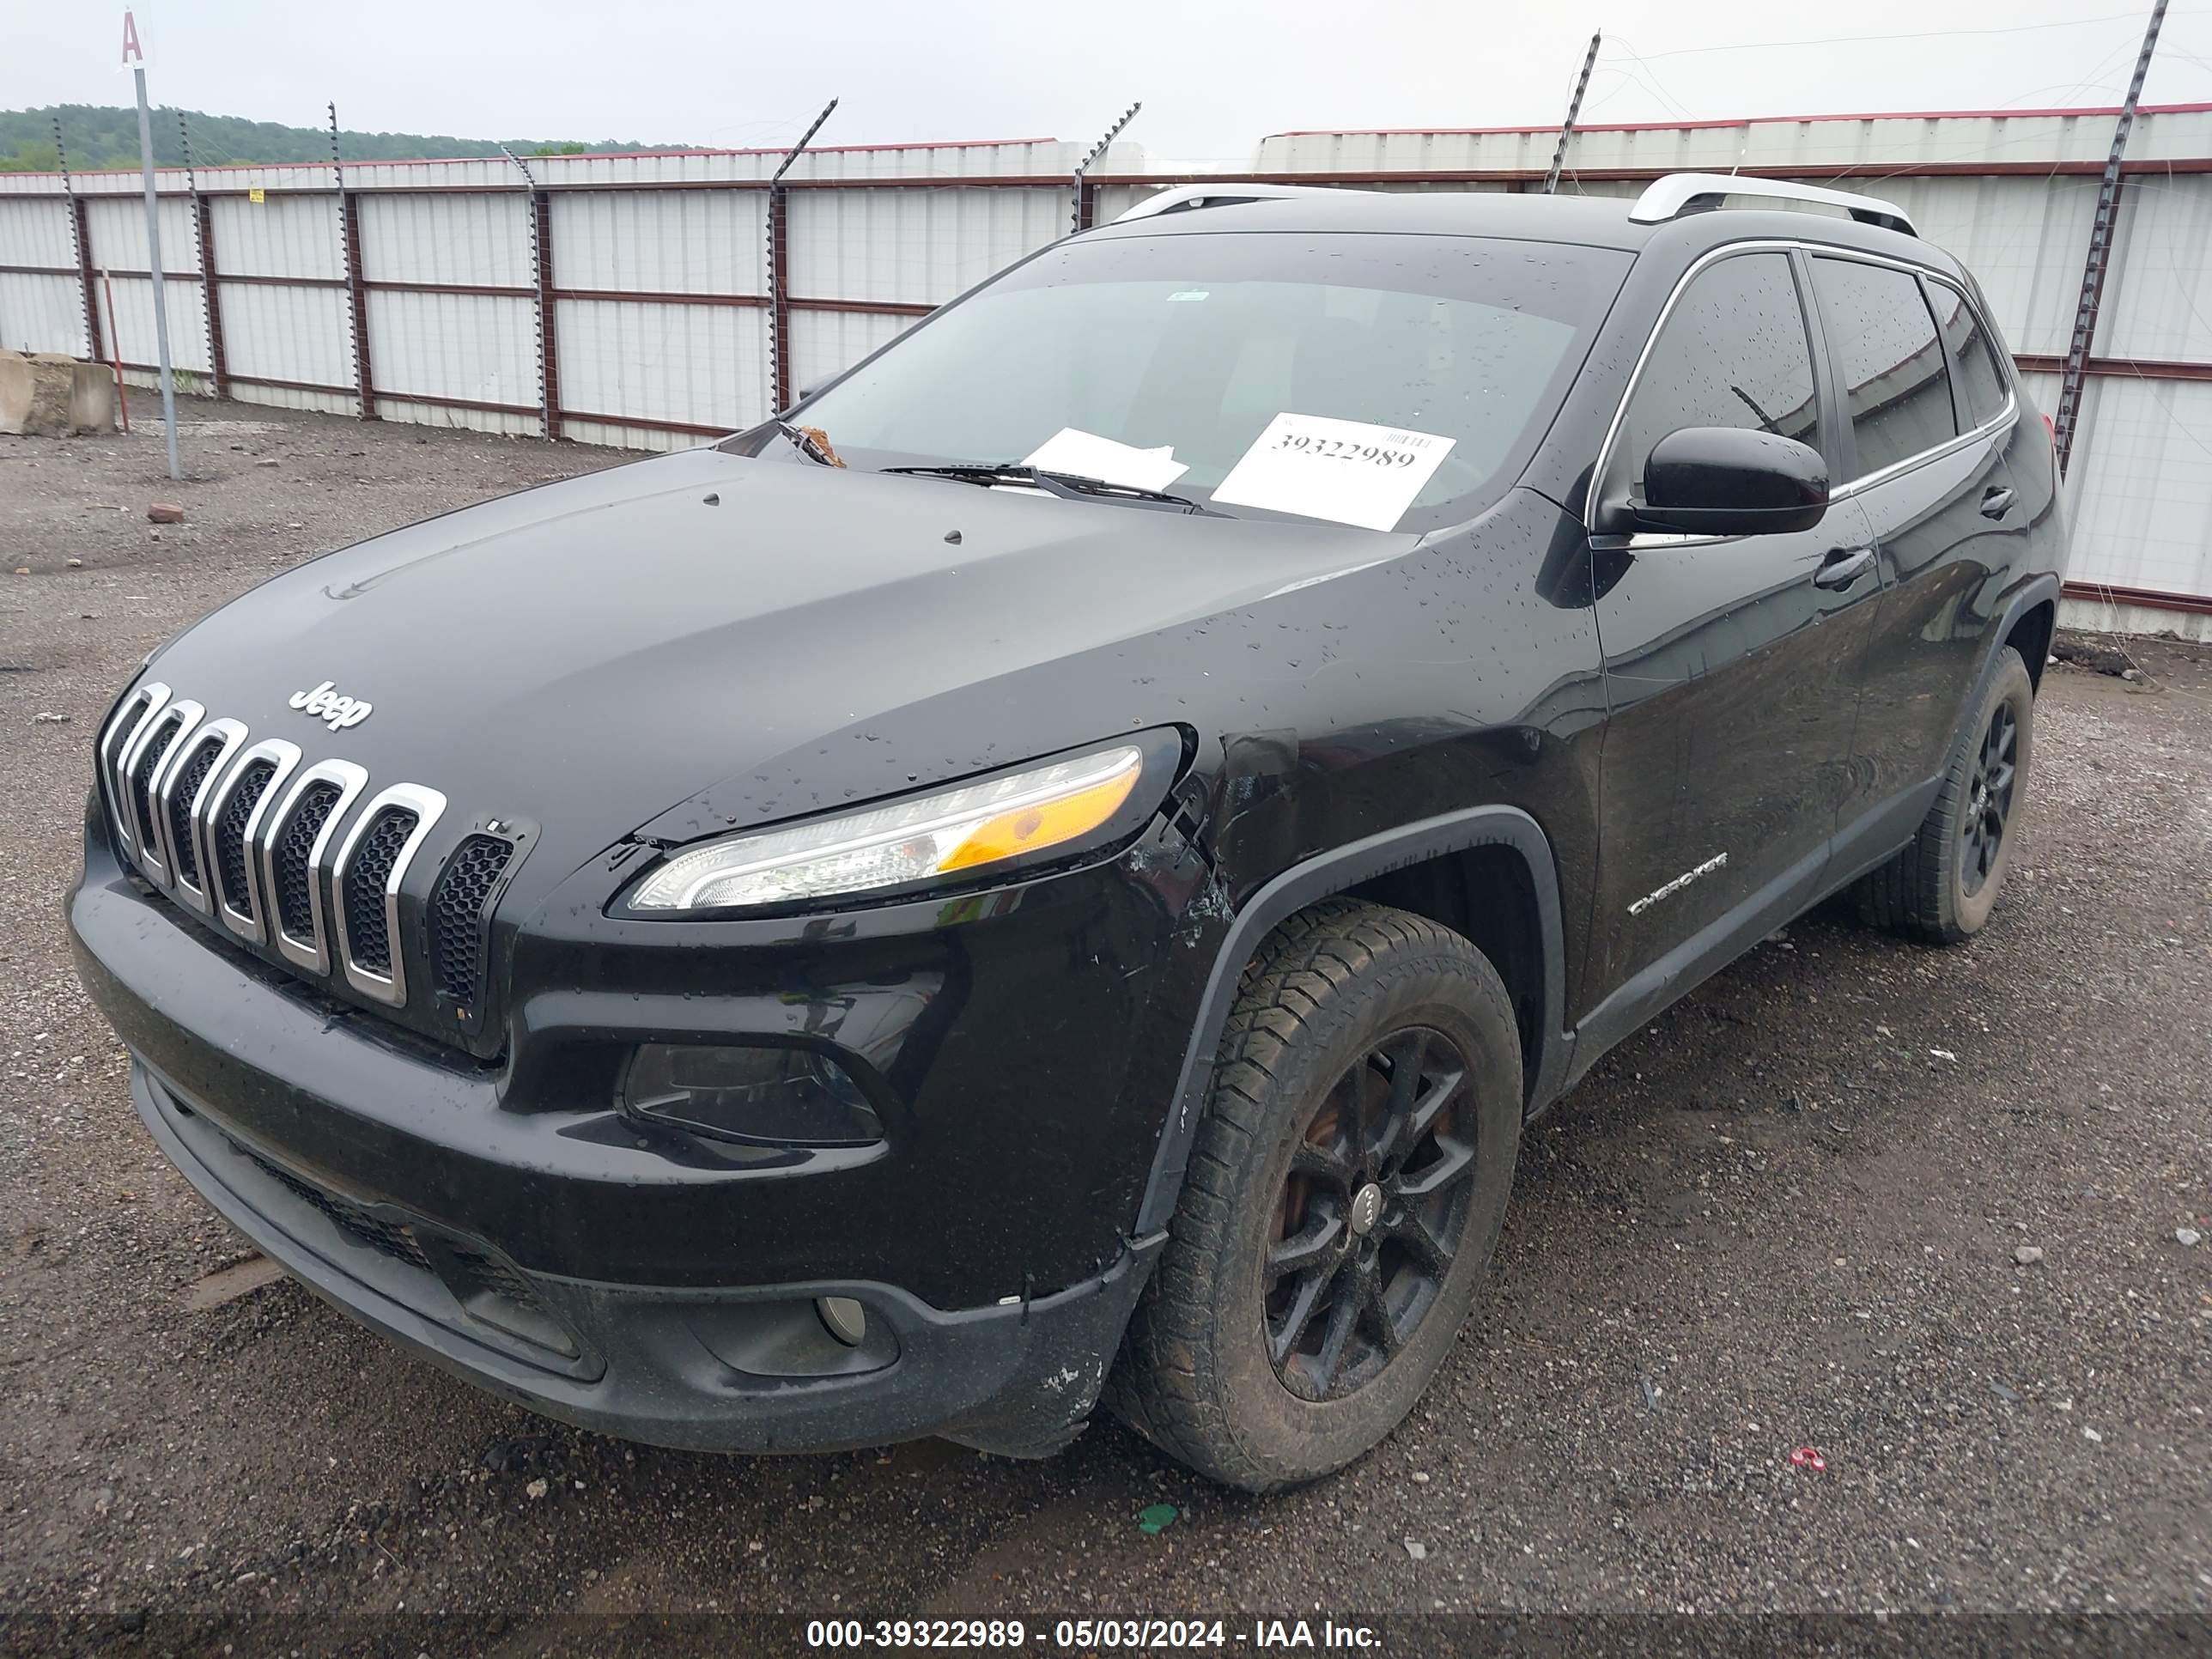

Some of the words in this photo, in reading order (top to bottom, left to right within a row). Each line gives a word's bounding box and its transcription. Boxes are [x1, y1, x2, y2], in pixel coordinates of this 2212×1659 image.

[123, 11, 143, 63] A
[1271, 434, 1415, 468] 39322989
[288, 679, 374, 733] Jeep
